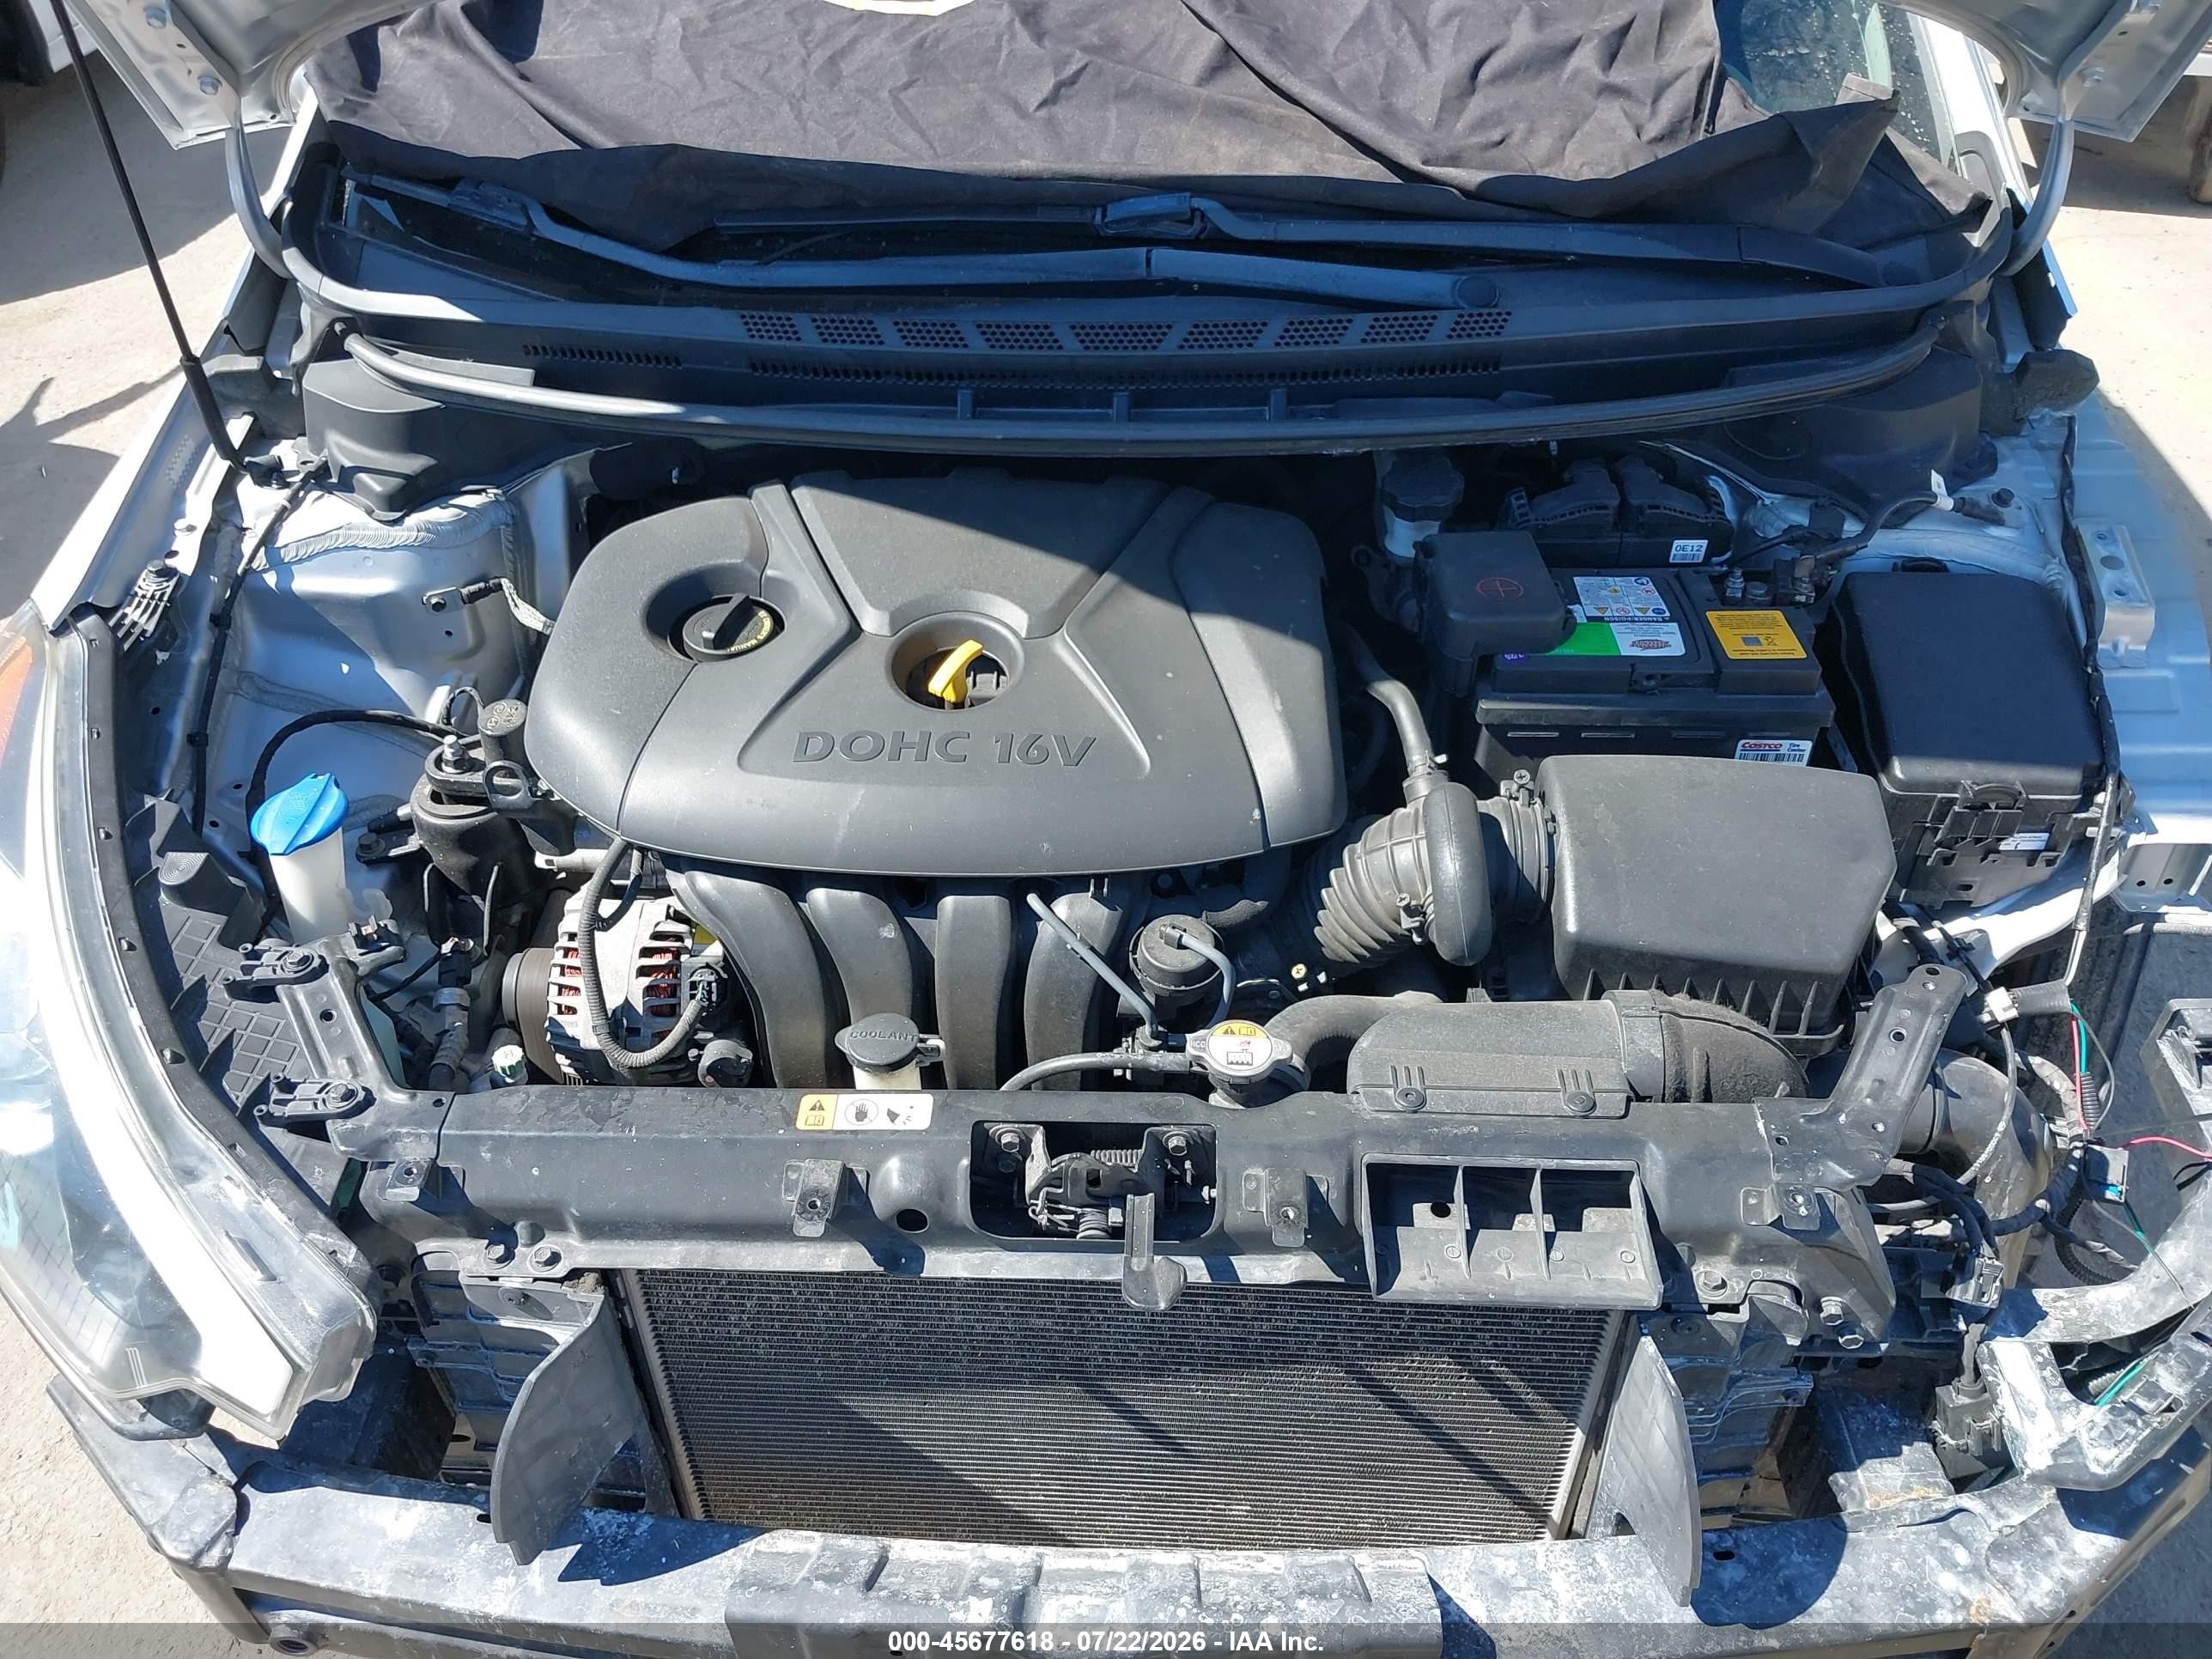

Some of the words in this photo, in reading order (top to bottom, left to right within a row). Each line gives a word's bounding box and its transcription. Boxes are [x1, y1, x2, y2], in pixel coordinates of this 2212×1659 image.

[793, 730, 971, 763] DOHC
[993, 732, 1098, 768] 16V
[849, 1030, 919, 1042] COOLANT
